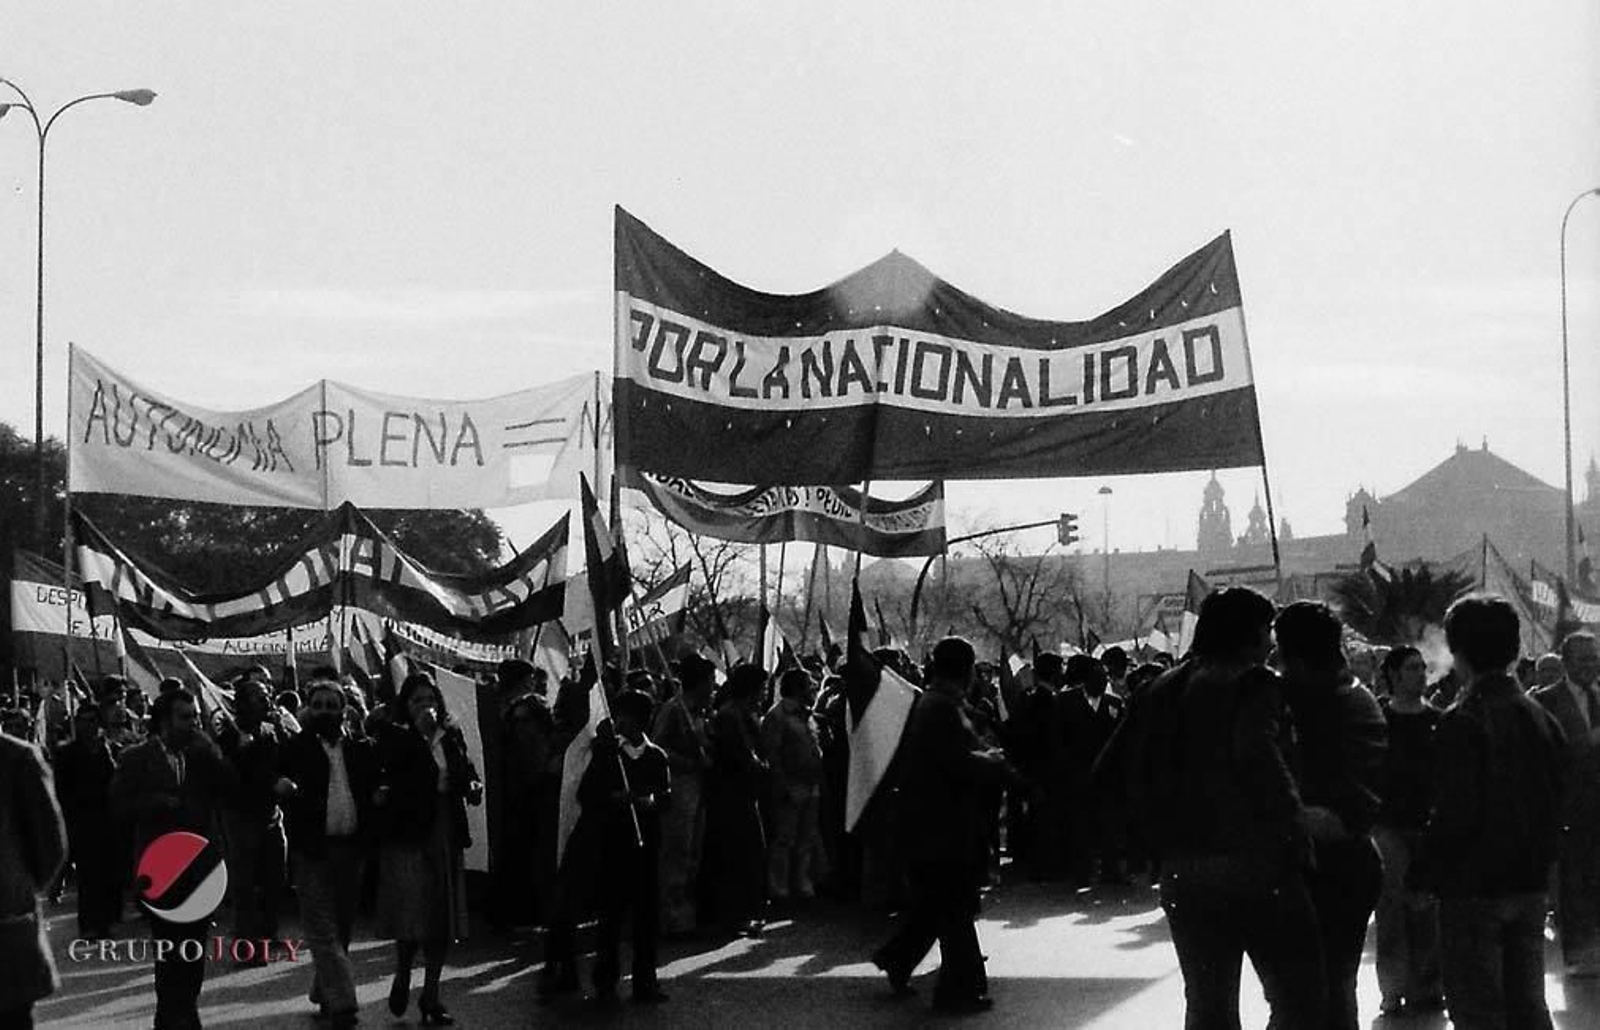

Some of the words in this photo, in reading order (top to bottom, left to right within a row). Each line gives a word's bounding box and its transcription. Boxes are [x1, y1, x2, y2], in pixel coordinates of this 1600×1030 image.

[629, 308, 728, 391] POR
[801, 323, 1224, 409] NACIONALIDAD
[85, 379, 294, 472] AUTONOMIA
[312, 408, 485, 469] PLENA
[222, 634, 330, 655] AUTONMIA
